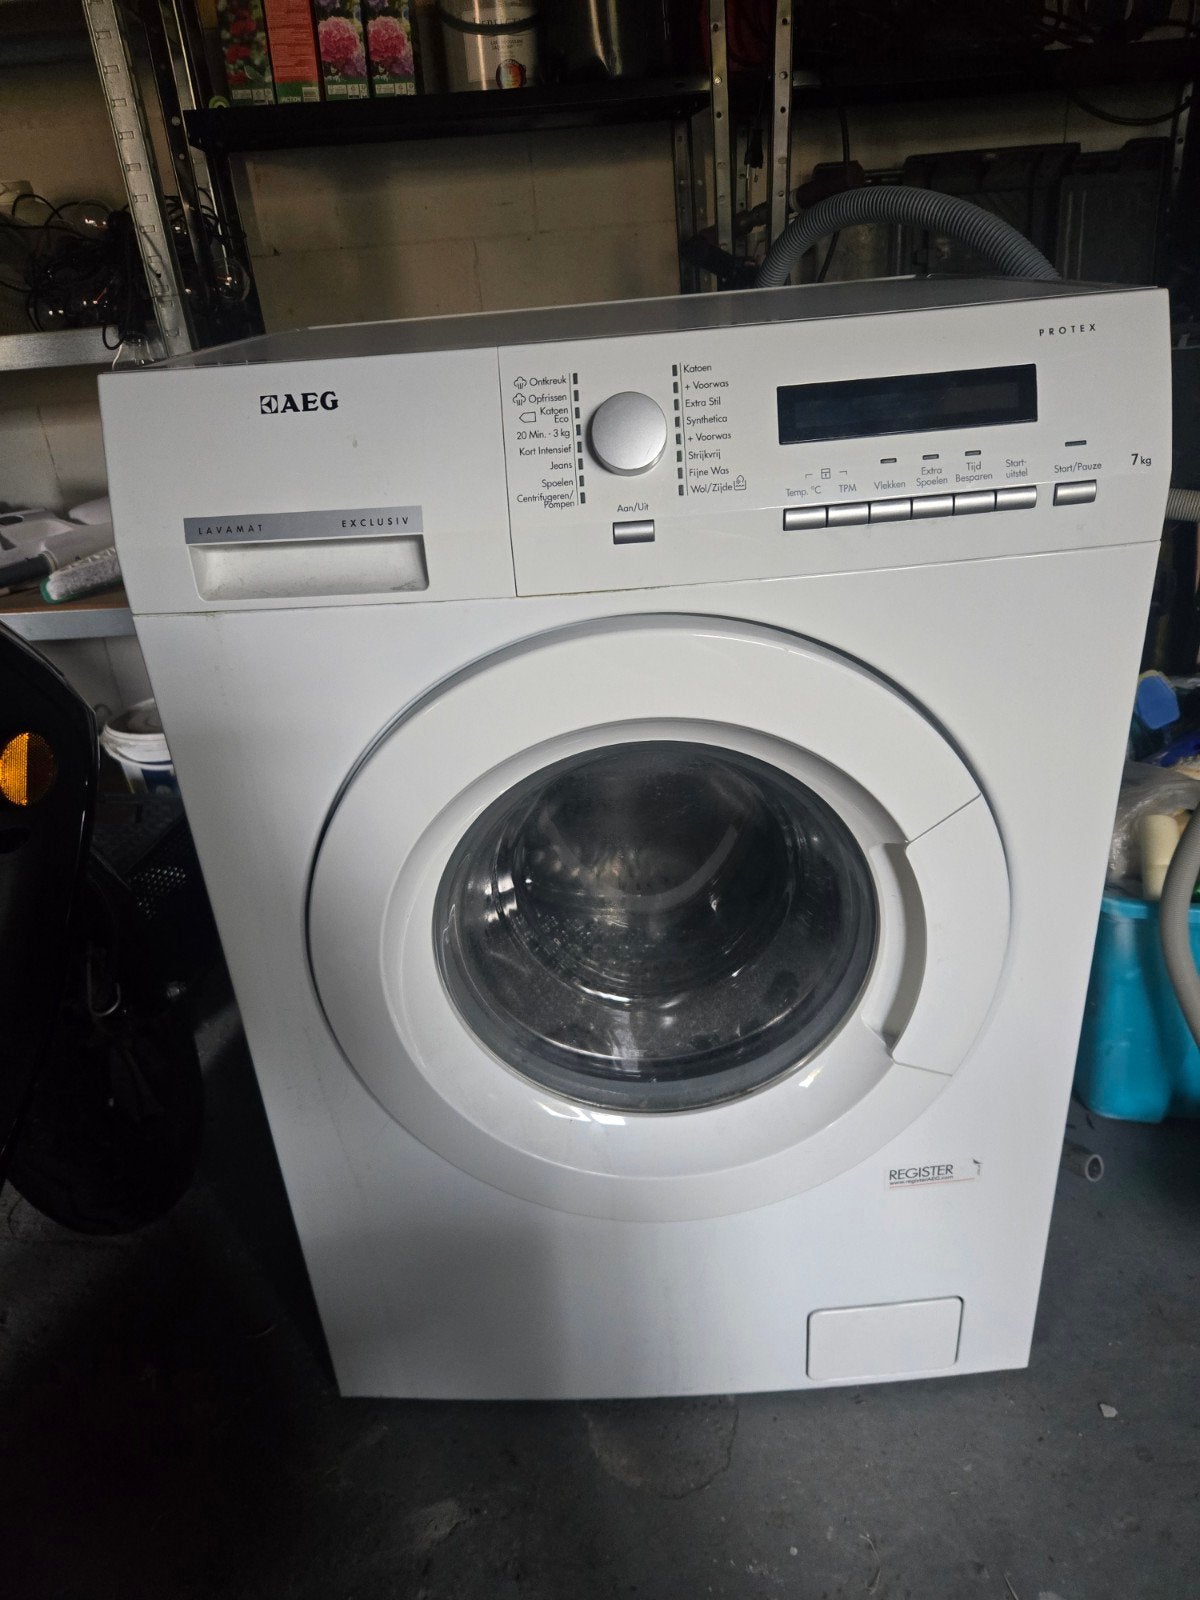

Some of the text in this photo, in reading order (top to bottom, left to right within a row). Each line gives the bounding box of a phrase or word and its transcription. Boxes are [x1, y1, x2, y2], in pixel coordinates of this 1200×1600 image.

[1038, 323, 1097, 336] PROTEX
[683, 363, 712, 373] Katoen
[529, 376, 567, 387] Ontkreuk
[692, 380, 729, 390] Voorwas
[281, 391, 339, 413] AEG
[528, 393, 567, 404] Opfrissen
[685, 397, 721, 408] Extra Stil
[539, 407, 569, 416] Katoen
[554, 415, 569, 423] Eco
[686, 415, 728, 426] Synthetica
[516, 431, 527, 440] 20
[529, 430, 547, 439] Min.
[553, 429, 559, 438] 3
[560, 429, 571, 440] kg
[695, 431, 732, 441] Voorwas
[519, 445, 572, 456] Kort Intensief
[688, 450, 721, 460] Strijkvrij
[550, 461, 573, 470] Jeans
[1131, 454, 1152, 467] 7 kg
[689, 466, 730, 477] Fijne Was
[921, 465, 942, 476] Extra
[966, 461, 982, 472] Tijd
[1054, 461, 1102, 474] Start/Pauze
[955, 471, 993, 483] Besparen
[1005, 468, 1028, 479] uitstel
[541, 478, 574, 489] Spoelen
[873, 479, 906, 490] Vlekken
[916, 475, 949, 488] Spoelen
[690, 482, 733, 494] Wol/Zijde
[786, 487, 809, 499] Temp.
[838, 483, 857, 493] TPM
[517, 491, 574, 504] Centrifugeren/
[543, 499, 575, 509] Pompen
[617, 503, 649, 513] Aan/Uit
[198, 517, 409, 535] LAVAMAT EXCLUSIV
[889, 1164, 954, 1181] REGISTER
